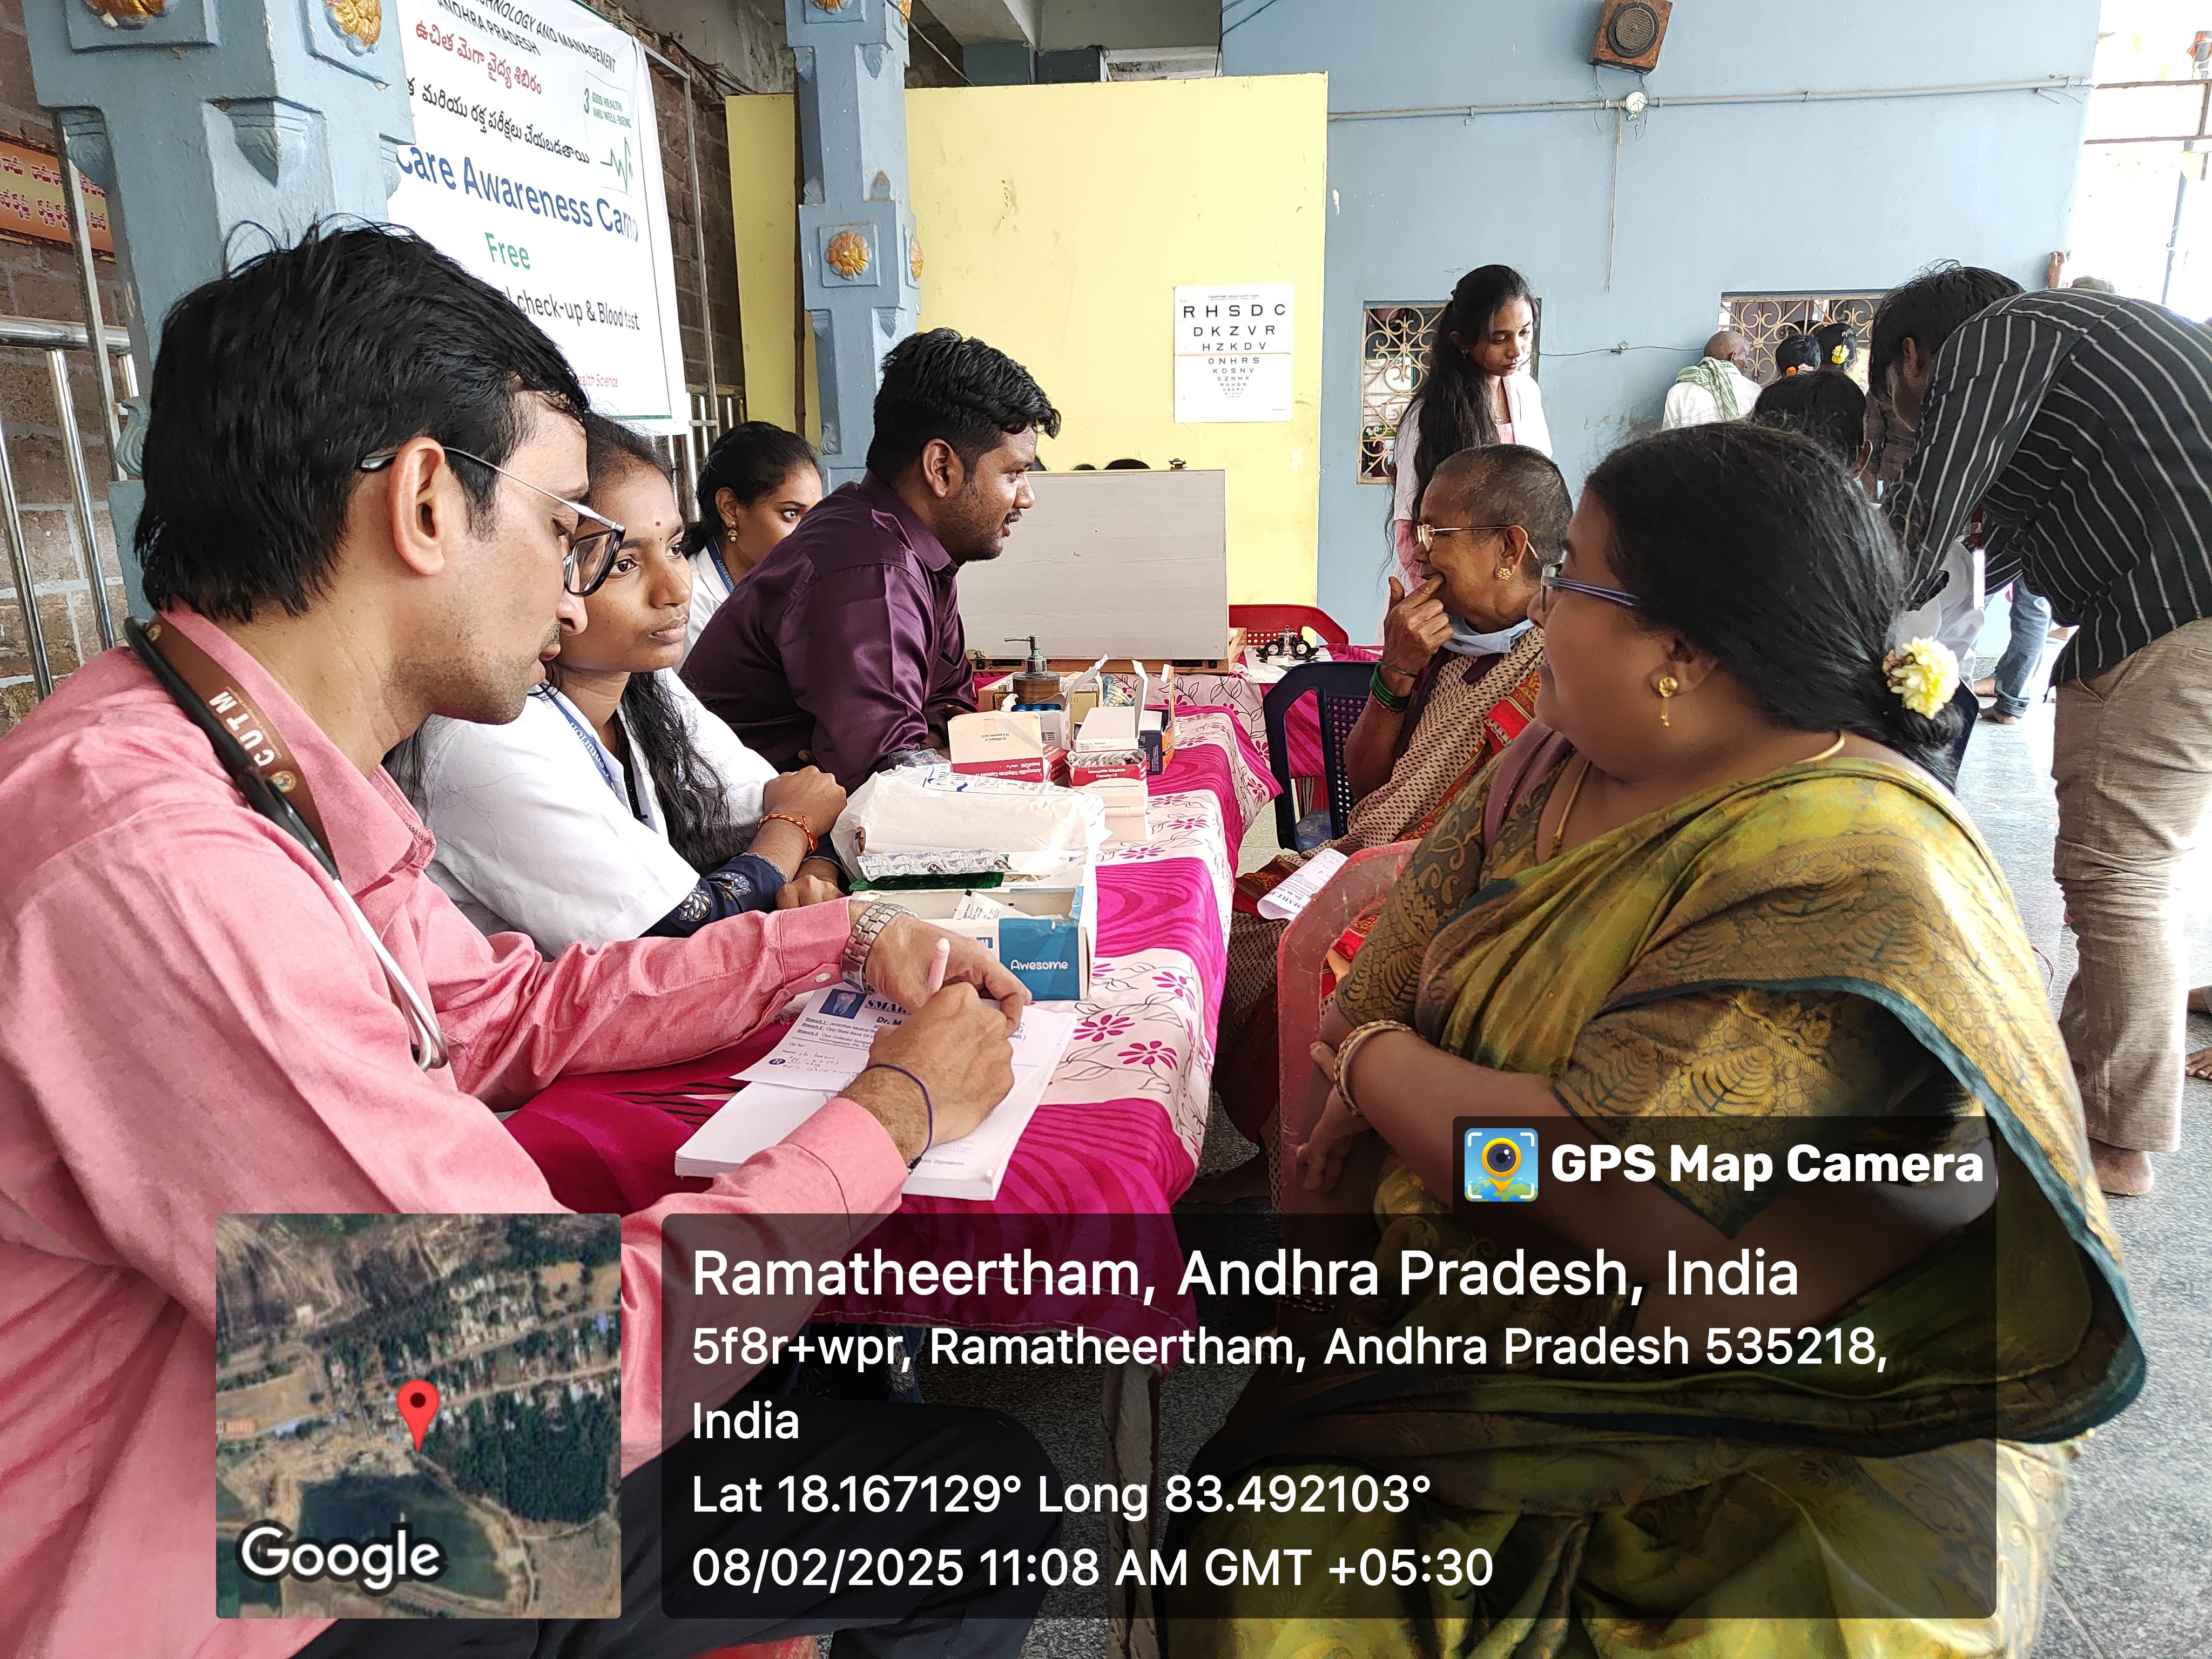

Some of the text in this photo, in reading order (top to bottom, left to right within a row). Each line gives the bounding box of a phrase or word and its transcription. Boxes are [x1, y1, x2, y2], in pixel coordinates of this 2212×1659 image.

[437, 0, 541, 56] ANDHRA PRADESH
[537, 22, 558, 43] AND
[558, 32, 616, 73] MANAGEMENT
[416, 21, 542, 95] ఉచిత మెగా వైద్య శిబిరం
[422, 84, 467, 117] మరియు
[471, 104, 487, 133] రక్త
[488, 111, 522, 142] పరీక్షలు
[584, 87, 589, 114] 3
[463, 156, 593, 227] Awareness
[596, 198, 639, 243] Camp
[484, 232, 530, 269] Free
[517, 289, 583, 326] check-up
[586, 300, 597, 322] &
[597, 301, 624, 327] Blood
[624, 309, 640, 331] test
[577, 373, 595, 386] ealth
[208, 691, 275, 767] CUTM
[1010, 959, 1068, 970] Awesome
[876, 1016, 890, 1024] Dr.
